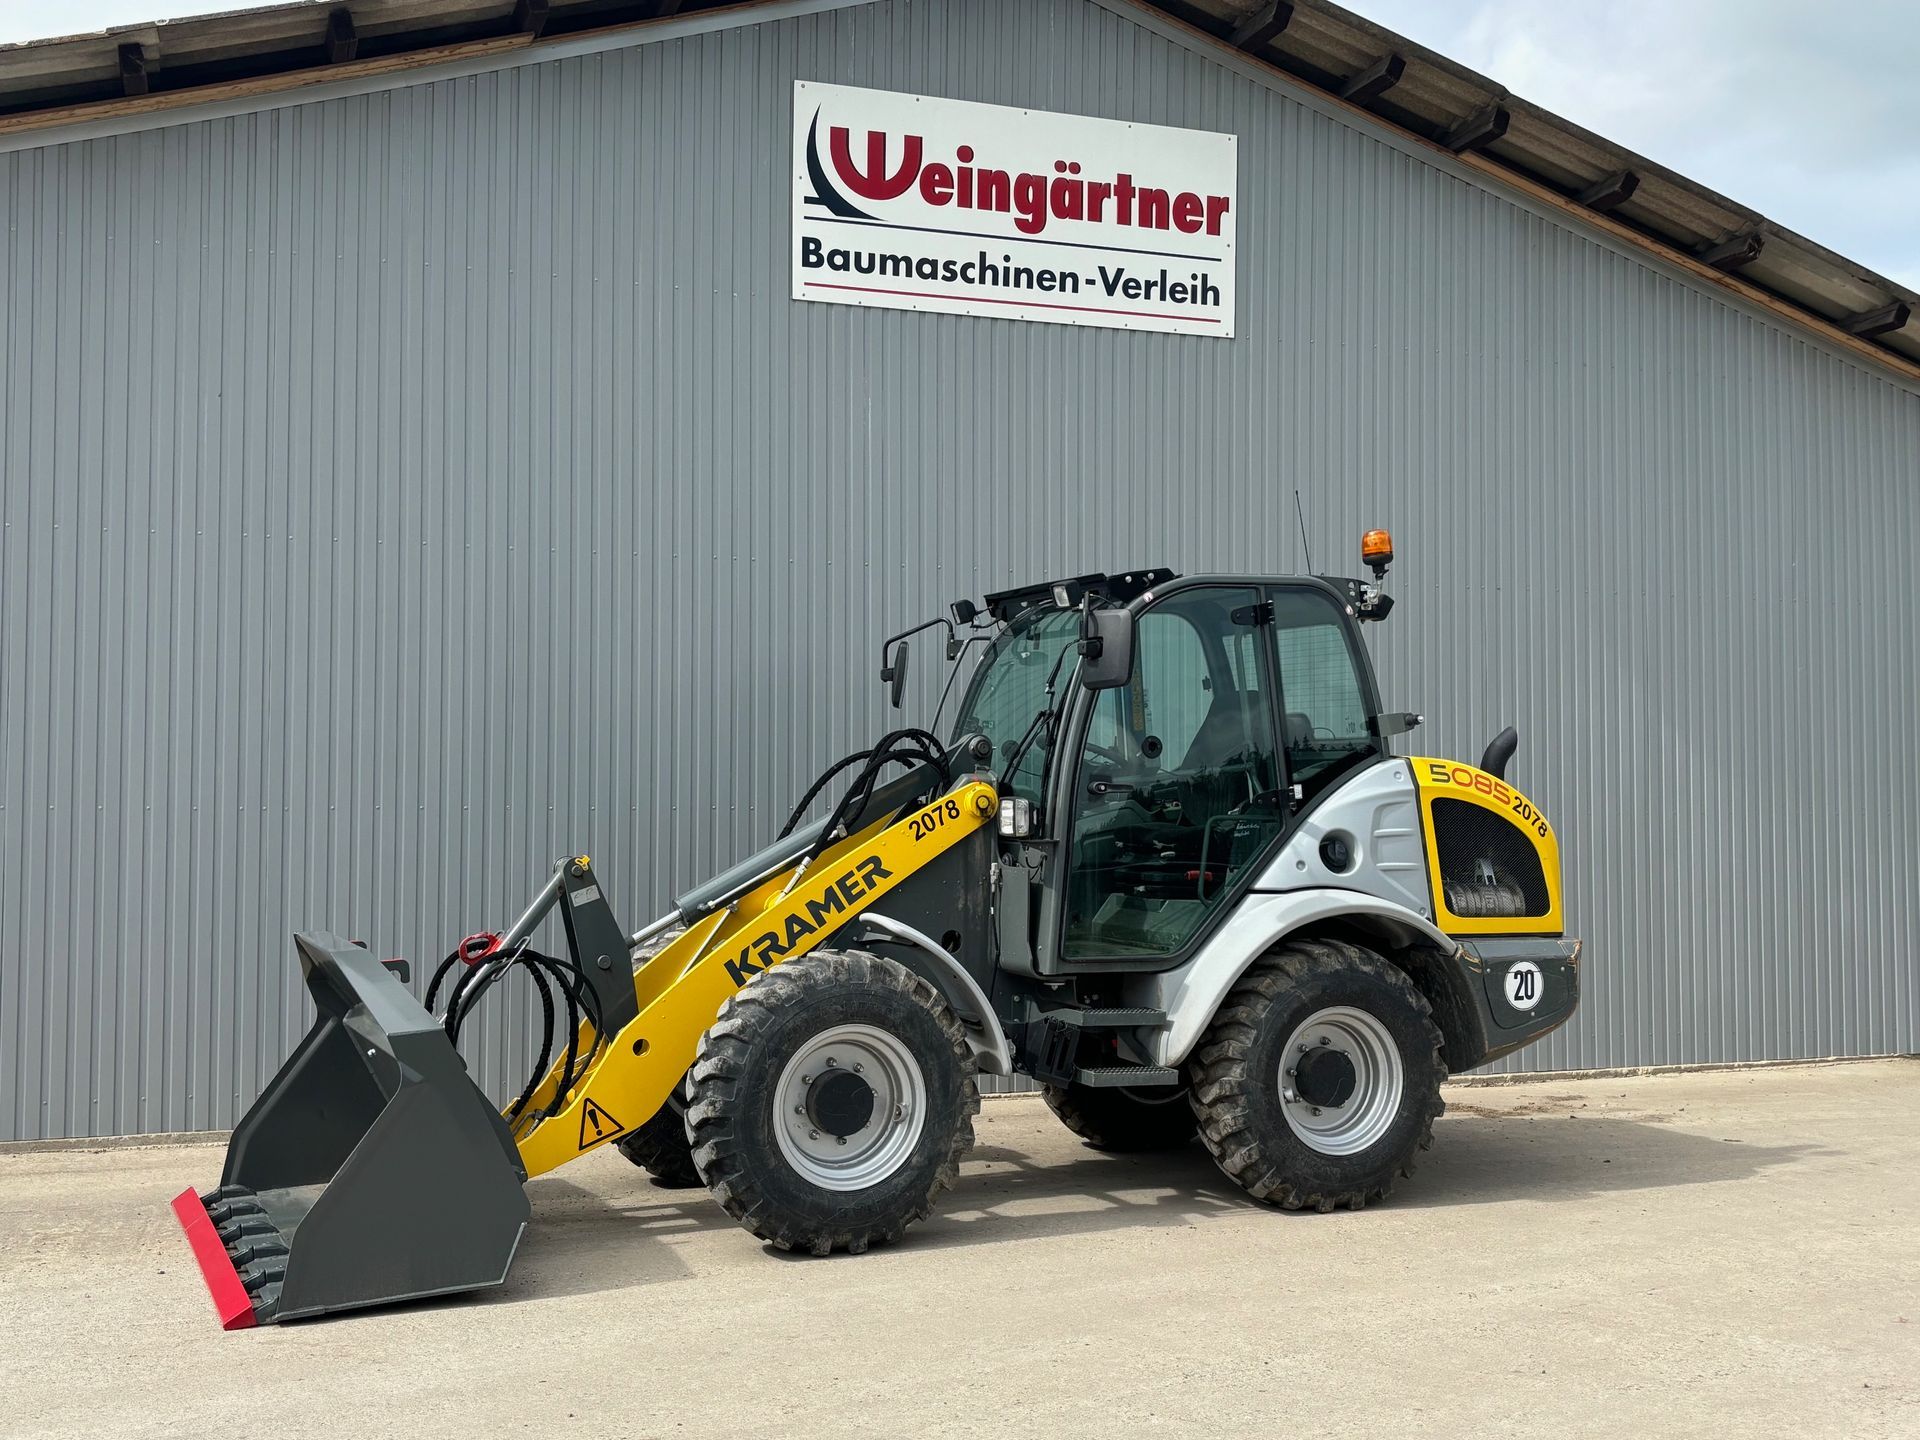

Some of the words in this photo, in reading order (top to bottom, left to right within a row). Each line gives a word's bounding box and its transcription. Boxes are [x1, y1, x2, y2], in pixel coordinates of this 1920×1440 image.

[829, 126, 1230, 236] Weingärtner
[801, 236, 1220, 306] Baumaschinen-Verleih
[1429, 764, 1511, 806] 5085
[908, 800, 960, 842] 2078
[1511, 796, 1548, 838] 2078
[723, 855, 893, 988] KRAMER
[1513, 970, 1535, 1001] 20
